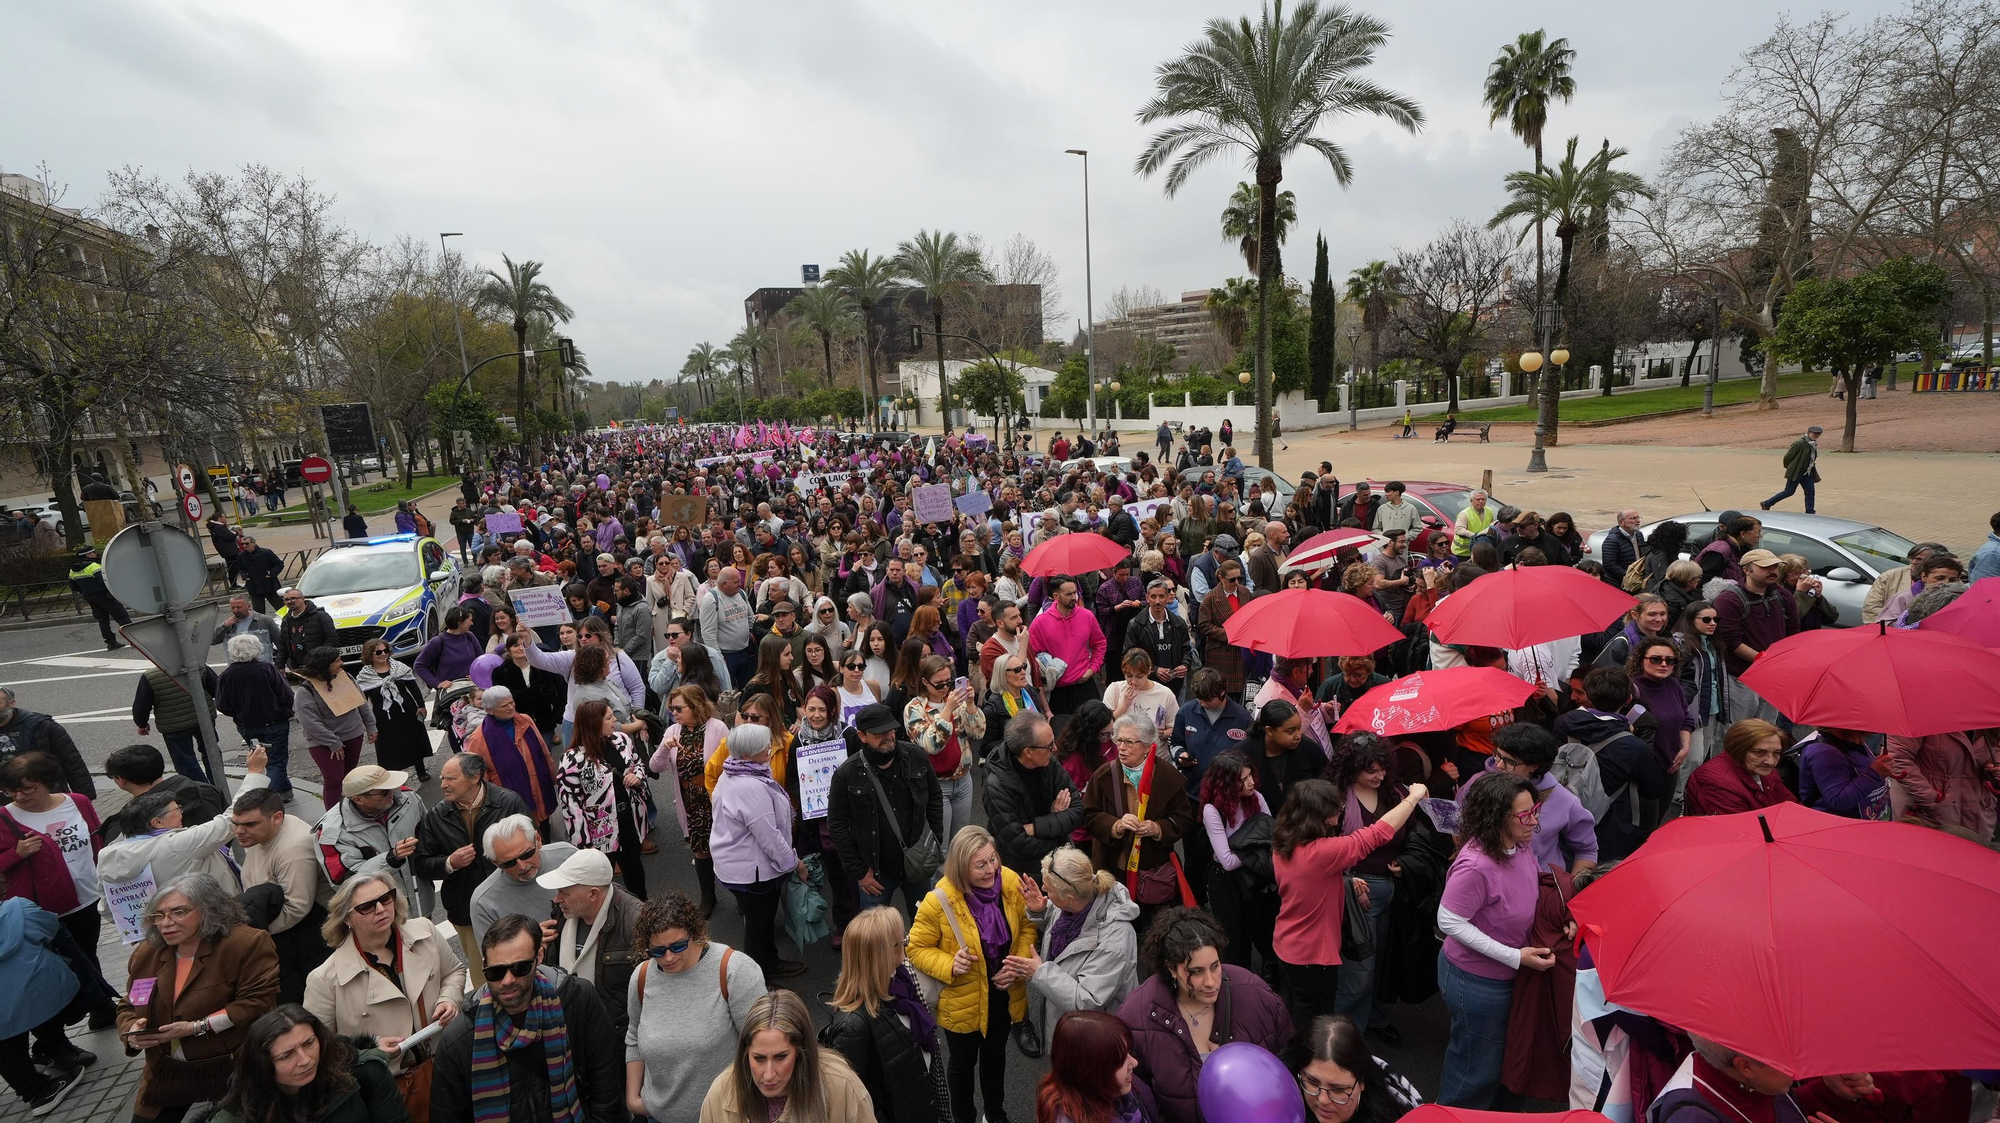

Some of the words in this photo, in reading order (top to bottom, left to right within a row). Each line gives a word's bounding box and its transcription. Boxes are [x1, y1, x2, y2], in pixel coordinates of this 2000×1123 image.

[828, 470, 866, 482] LAICISO
[725, 605, 747, 617] BRONX
[808, 745, 840, 754] DIVERSIDAD
[55, 824, 78, 837] SOY
